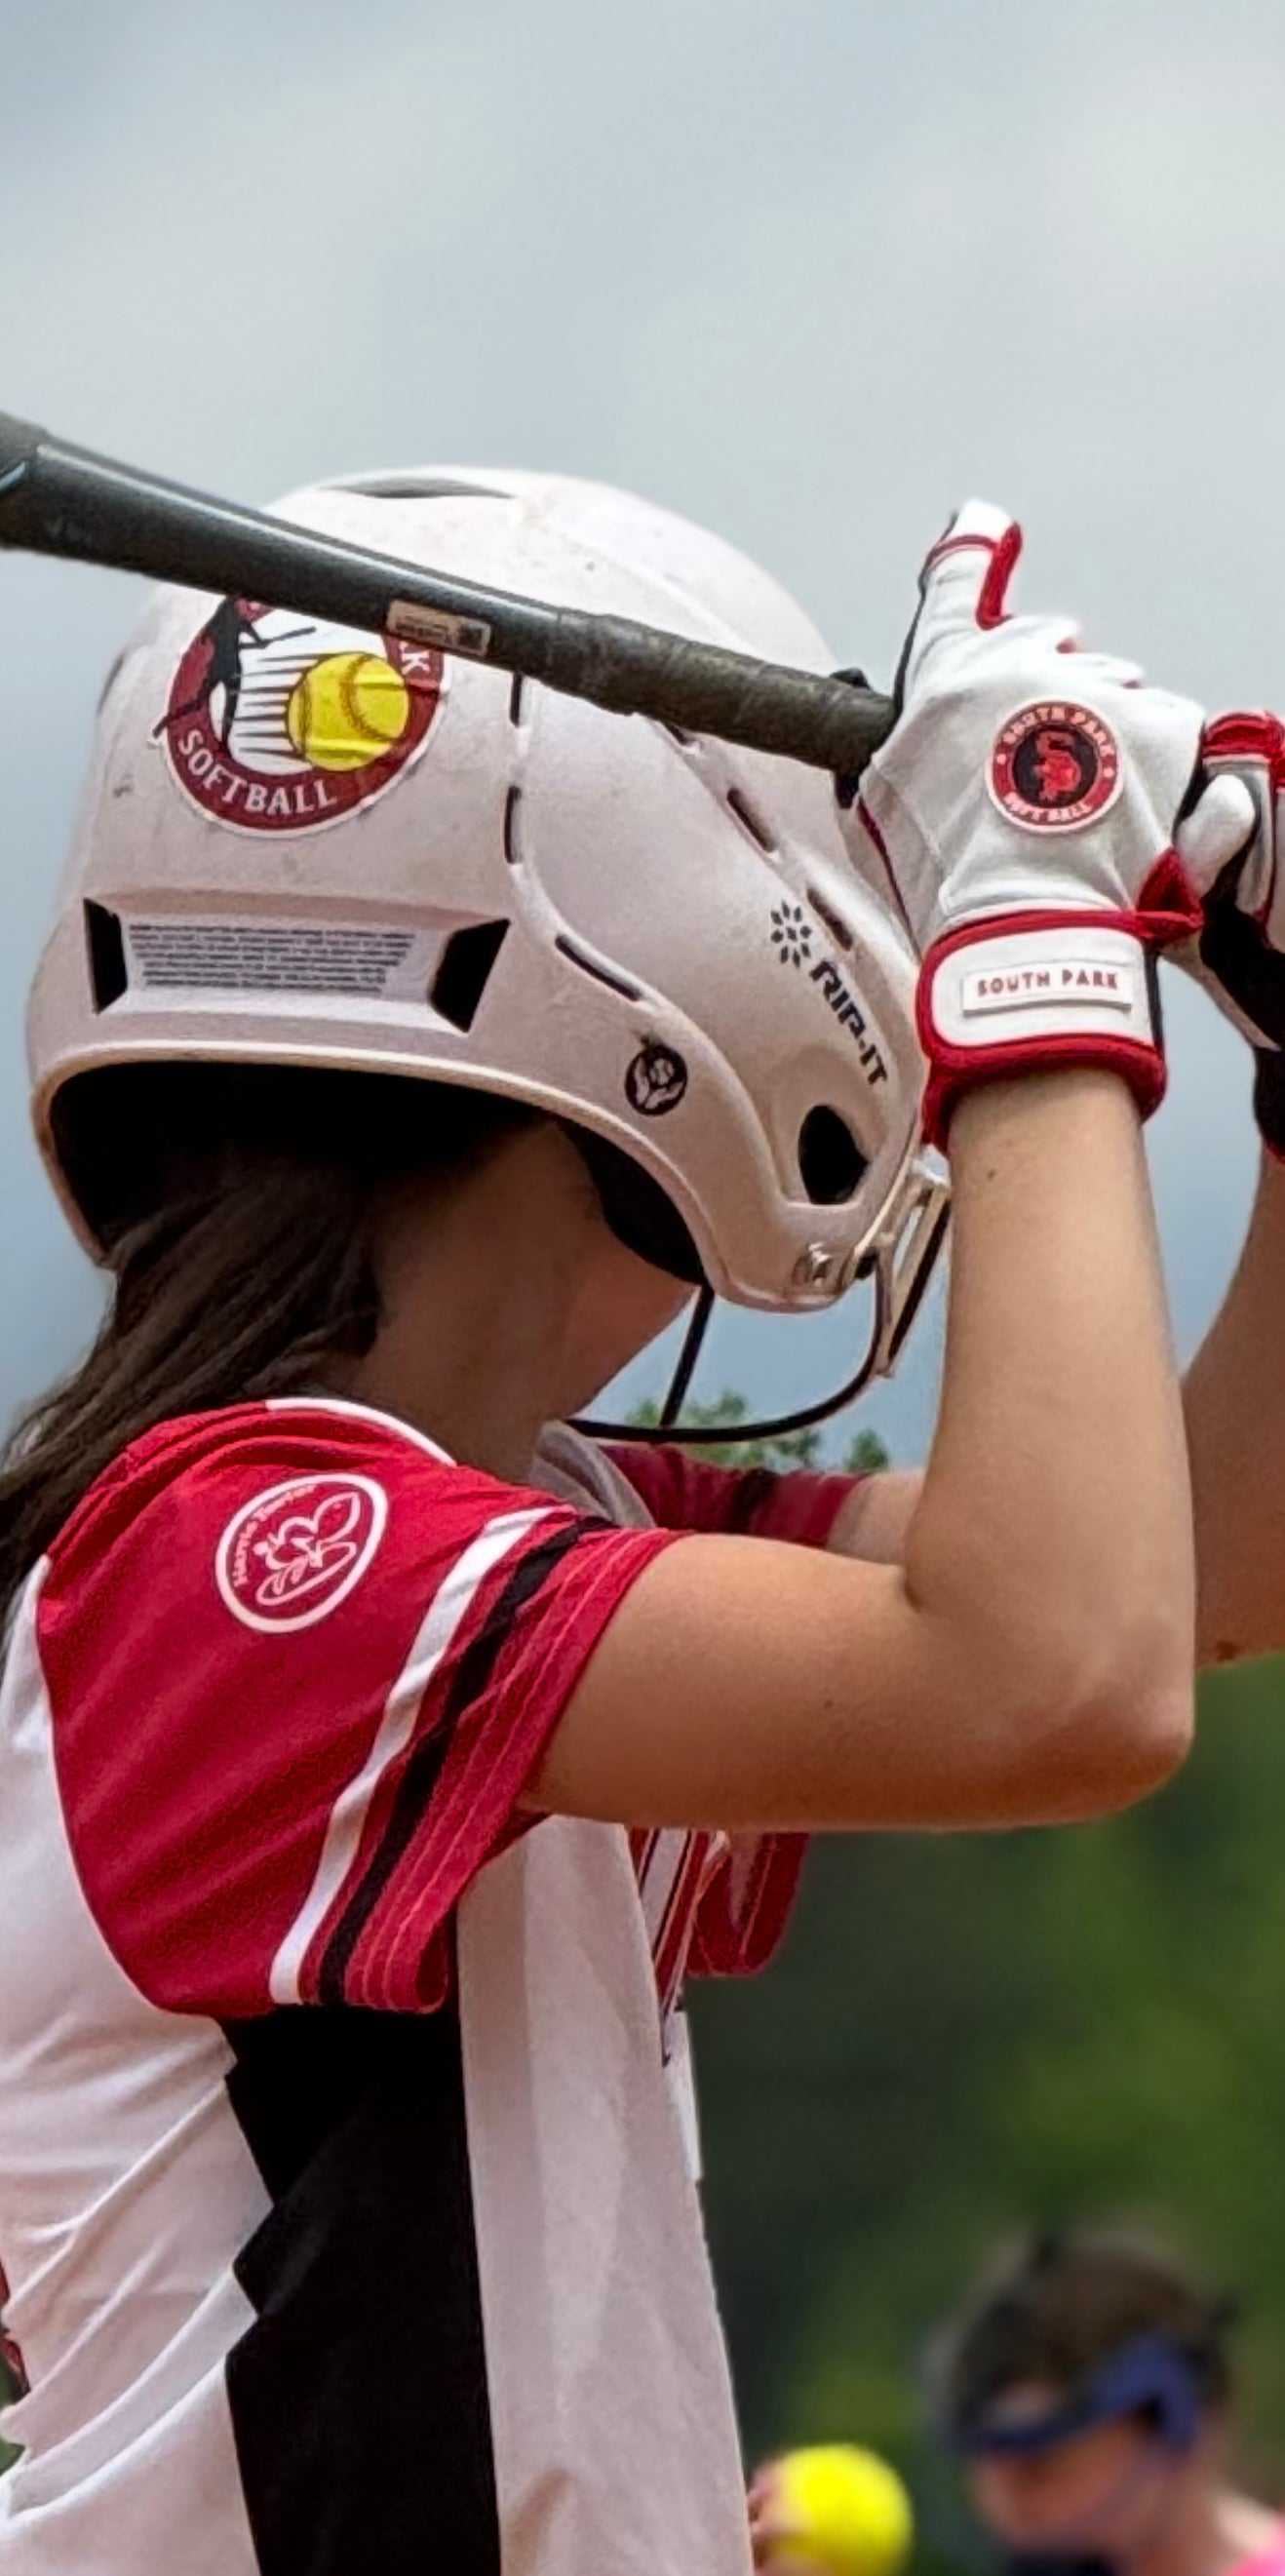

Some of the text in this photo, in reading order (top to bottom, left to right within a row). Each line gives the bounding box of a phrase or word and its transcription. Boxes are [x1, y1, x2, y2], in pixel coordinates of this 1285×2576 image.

[177, 728, 337, 816] SOFTBALL
[808, 960, 887, 1085] RIP-IT
[977, 969, 1118, 997] SOUTH PARK
